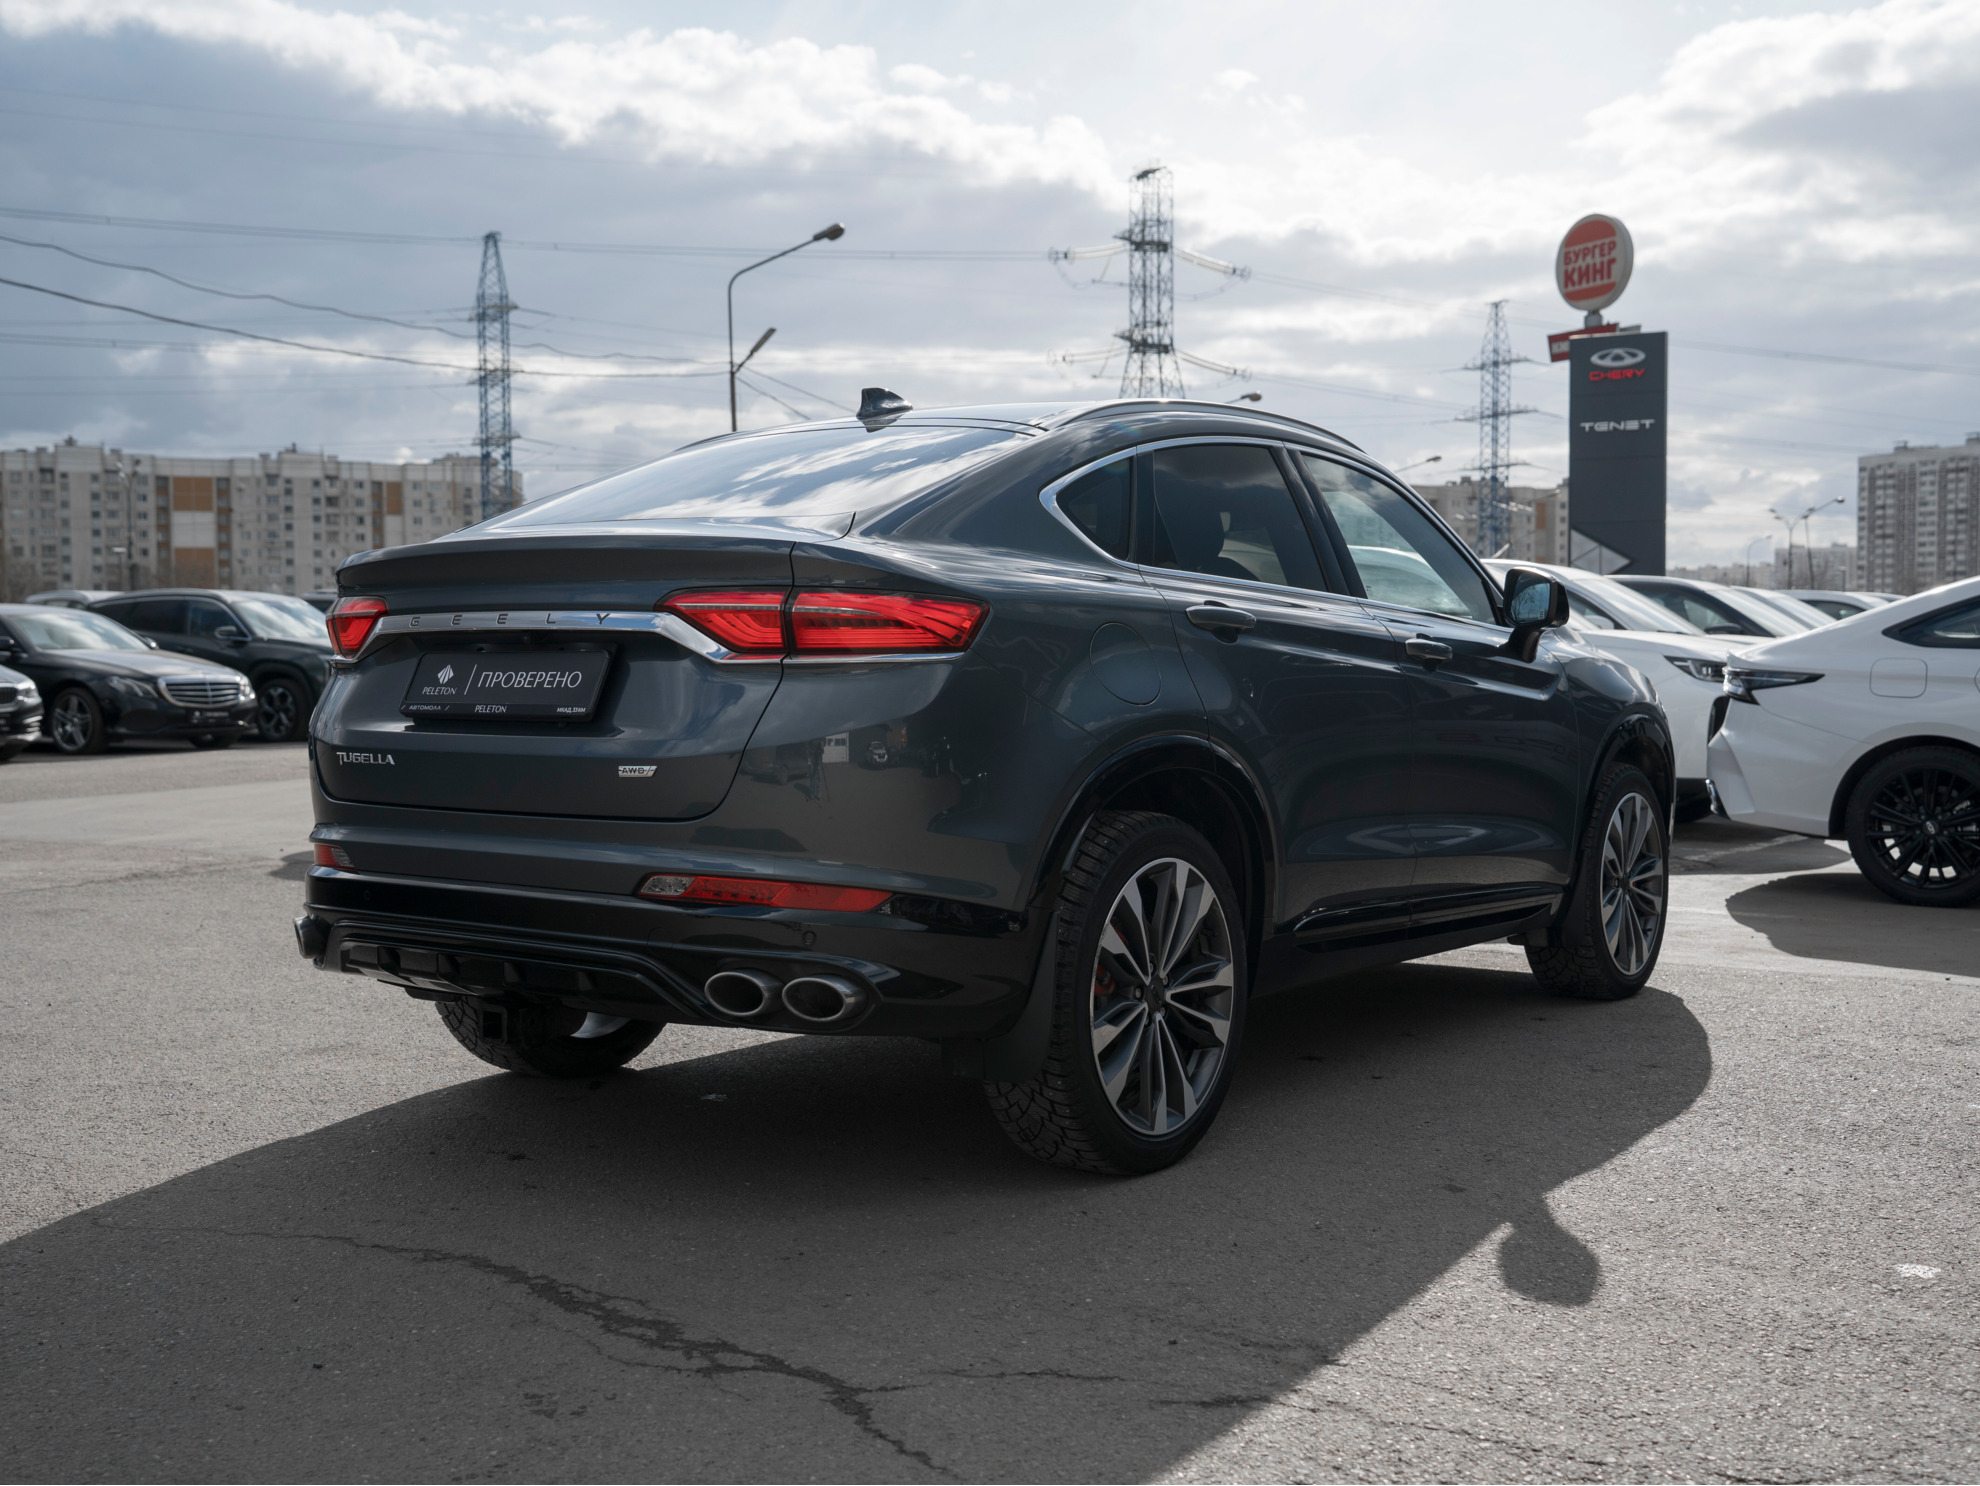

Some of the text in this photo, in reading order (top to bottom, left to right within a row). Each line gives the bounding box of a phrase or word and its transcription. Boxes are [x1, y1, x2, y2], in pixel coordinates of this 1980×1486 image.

[1563, 240, 1617, 266] БУРГЕР
[1563, 257, 1617, 290] КИНГ
[1589, 368, 1645, 381] CHERY
[1580, 419, 1655, 432] TENET
[409, 613, 611, 628] GEELY
[477, 671, 582, 688] ПРОВЕРЕНО
[422, 686, 457, 695] PELETON
[474, 704, 507, 714] PELETON
[336, 751, 395, 766] TUGELLA
[621, 767, 645, 775] AWD
